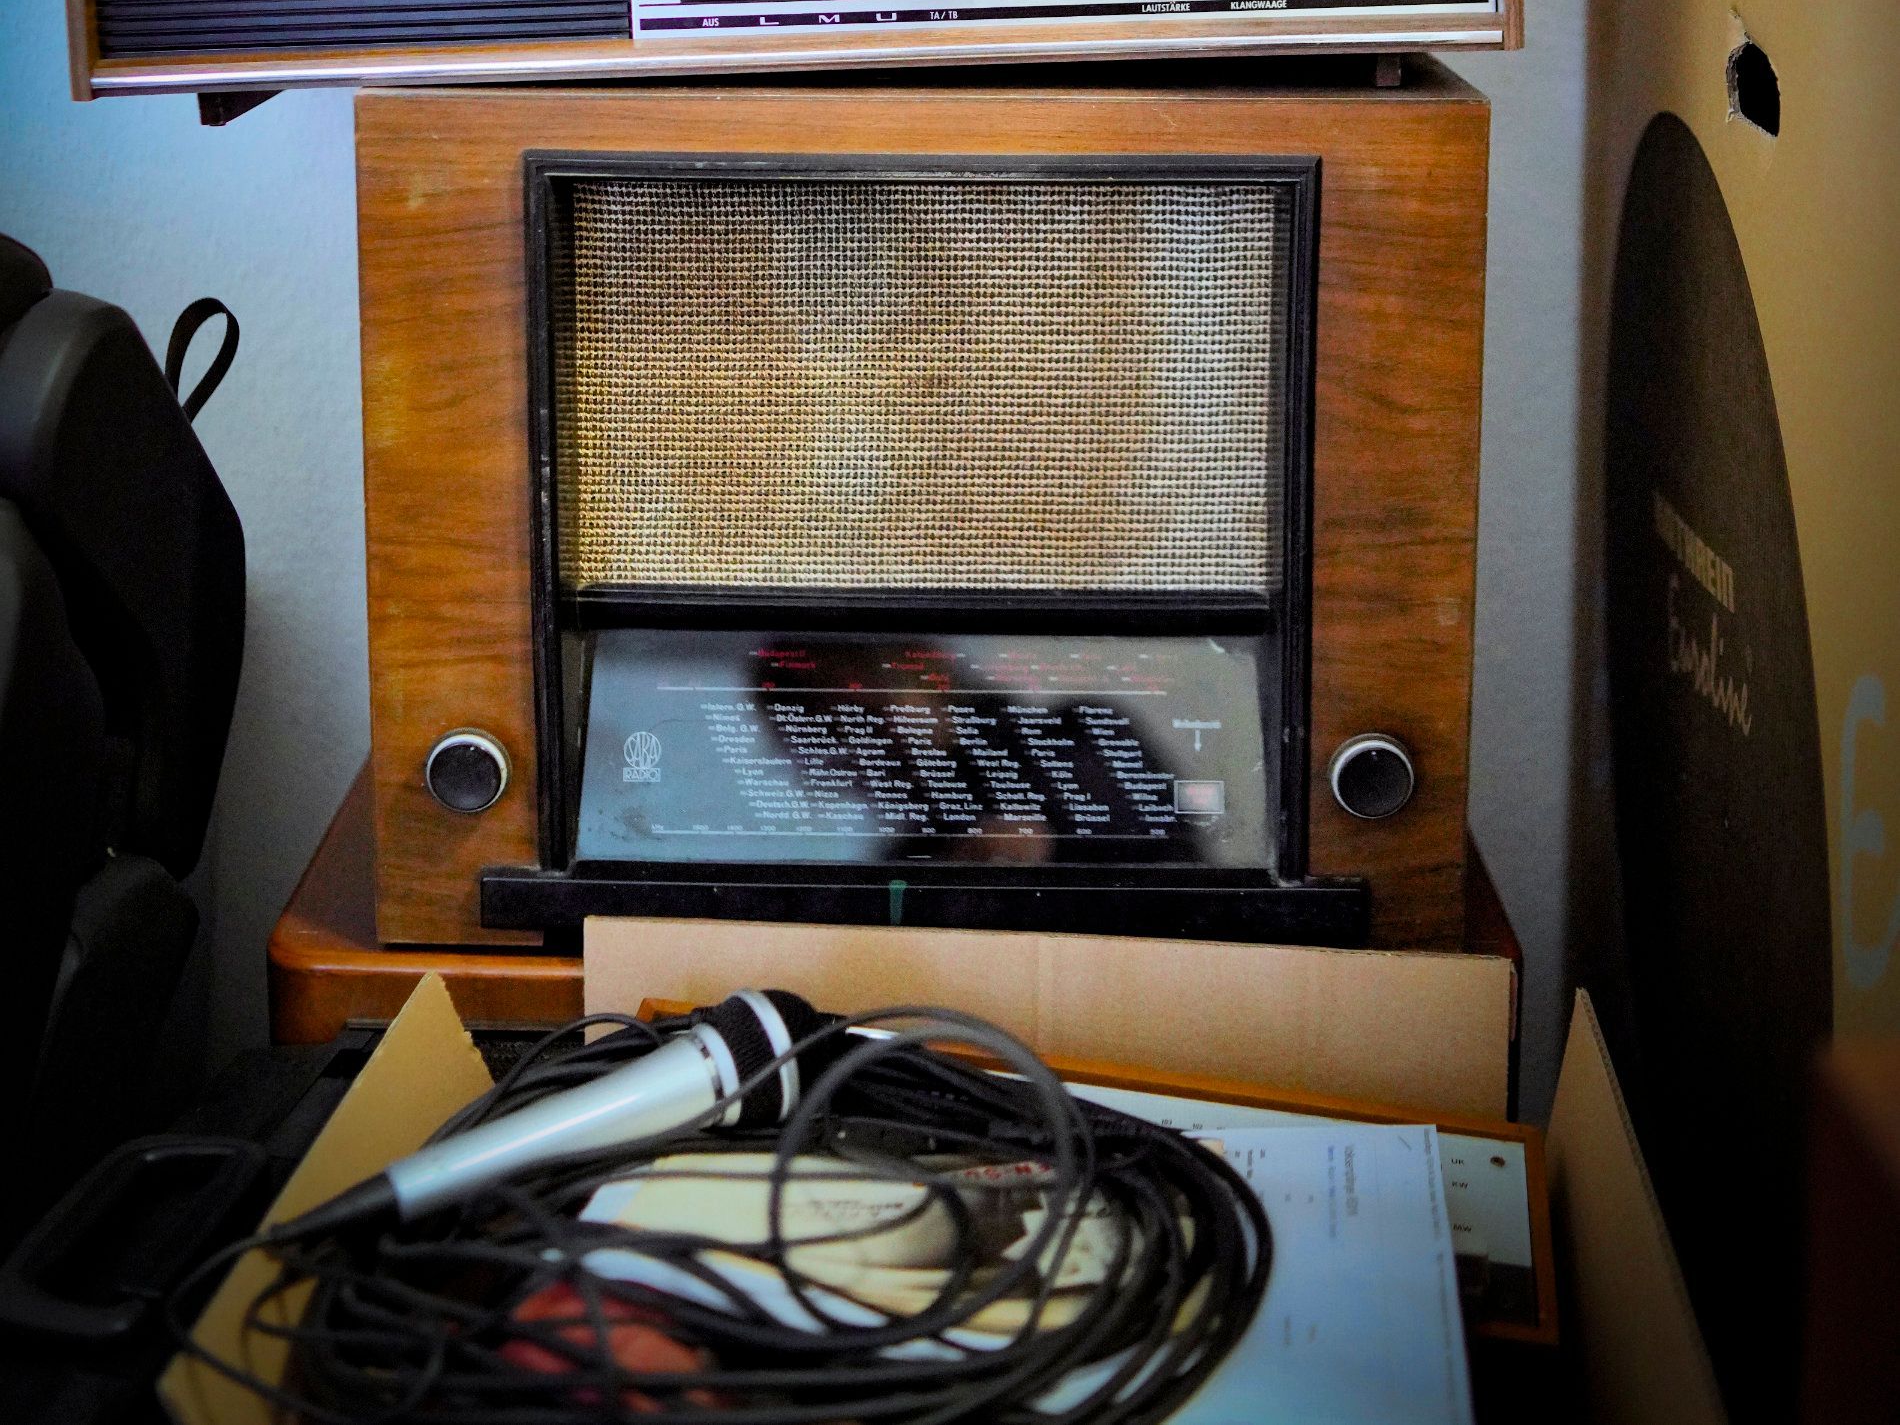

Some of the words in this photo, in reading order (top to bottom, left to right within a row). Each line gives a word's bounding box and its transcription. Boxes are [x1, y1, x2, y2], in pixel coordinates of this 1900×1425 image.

[1141, 1, 1191, 13] LAUTSTÄRKE
[702, 17, 720, 27] AUS
[818, 14, 841, 24] M
[624, 769, 660, 781] RADIO
